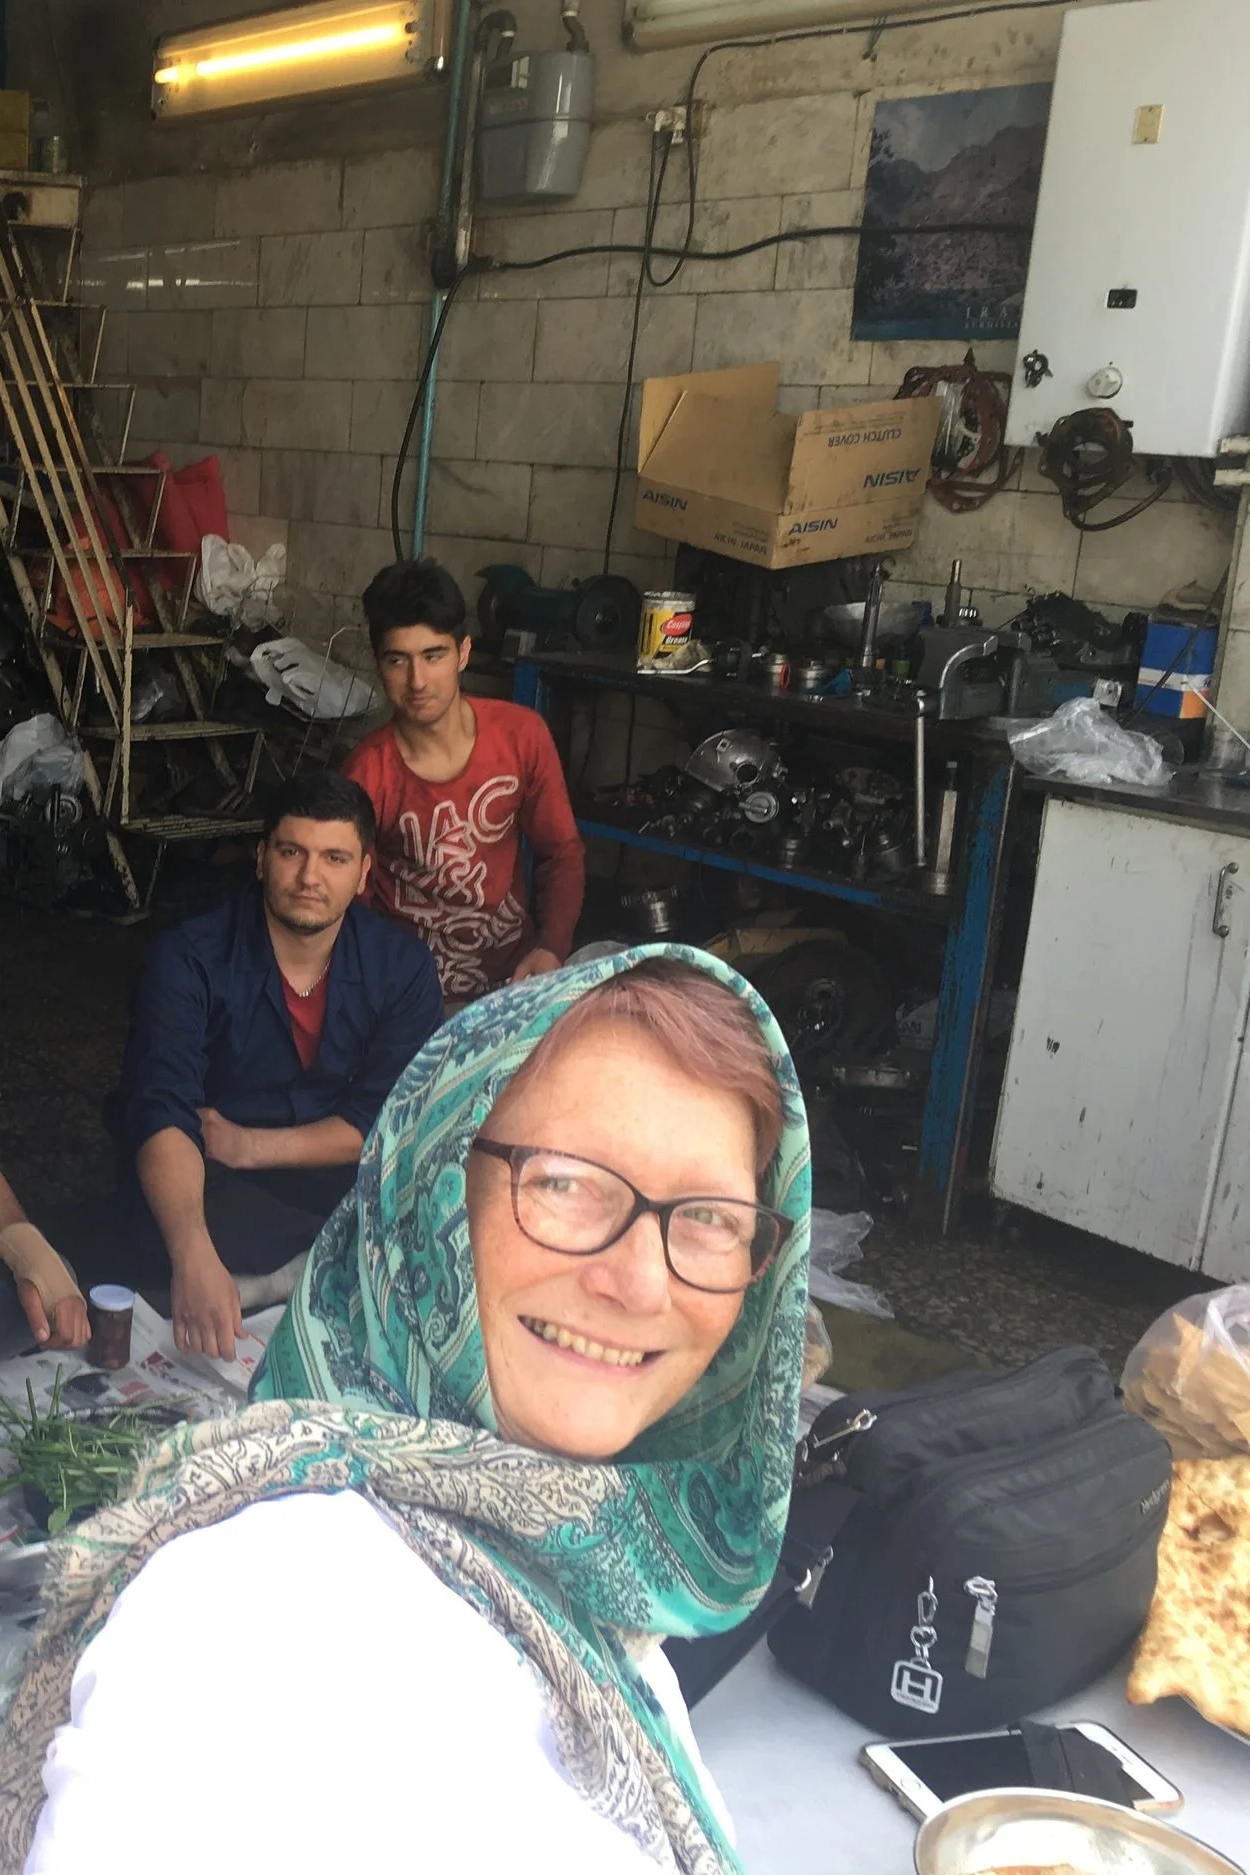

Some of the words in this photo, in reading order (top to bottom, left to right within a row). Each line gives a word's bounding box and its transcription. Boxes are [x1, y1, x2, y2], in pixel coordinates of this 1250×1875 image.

[827, 433, 860, 447] COVER
[863, 428, 902, 442] CLUTCH
[862, 467, 921, 489] AISIN
[642, 488, 688, 511] AISIN
[788, 517, 839, 536] AISIN
